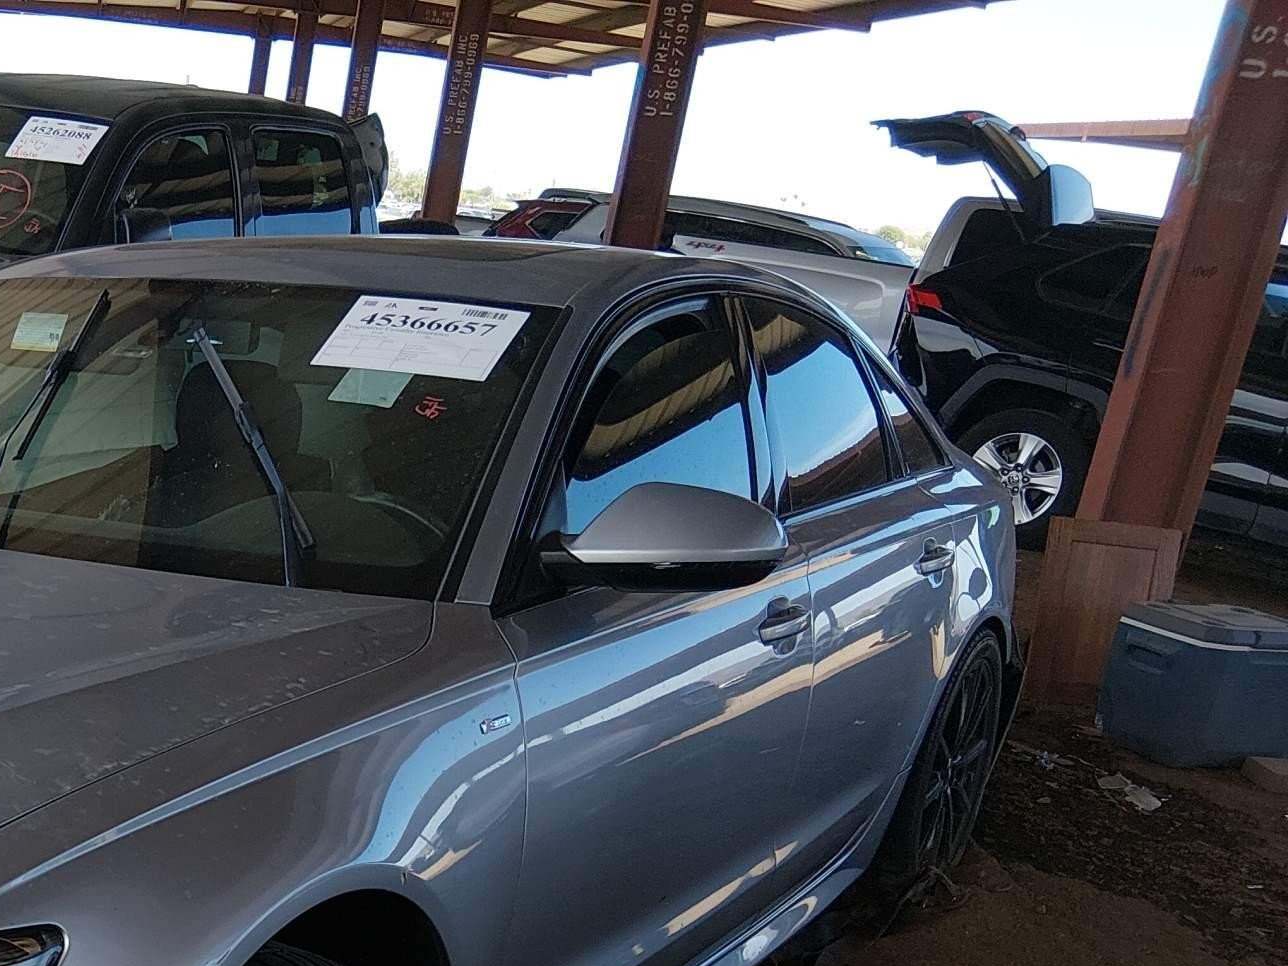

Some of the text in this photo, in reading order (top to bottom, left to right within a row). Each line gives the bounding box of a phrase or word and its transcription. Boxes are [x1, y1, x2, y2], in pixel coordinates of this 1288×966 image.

[653, 6, 677, 73] PREFAB
[447, 59, 465, 106] PREFAB
[29, 125, 94, 141] 45262088
[360, 311, 498, 337] 45366657
